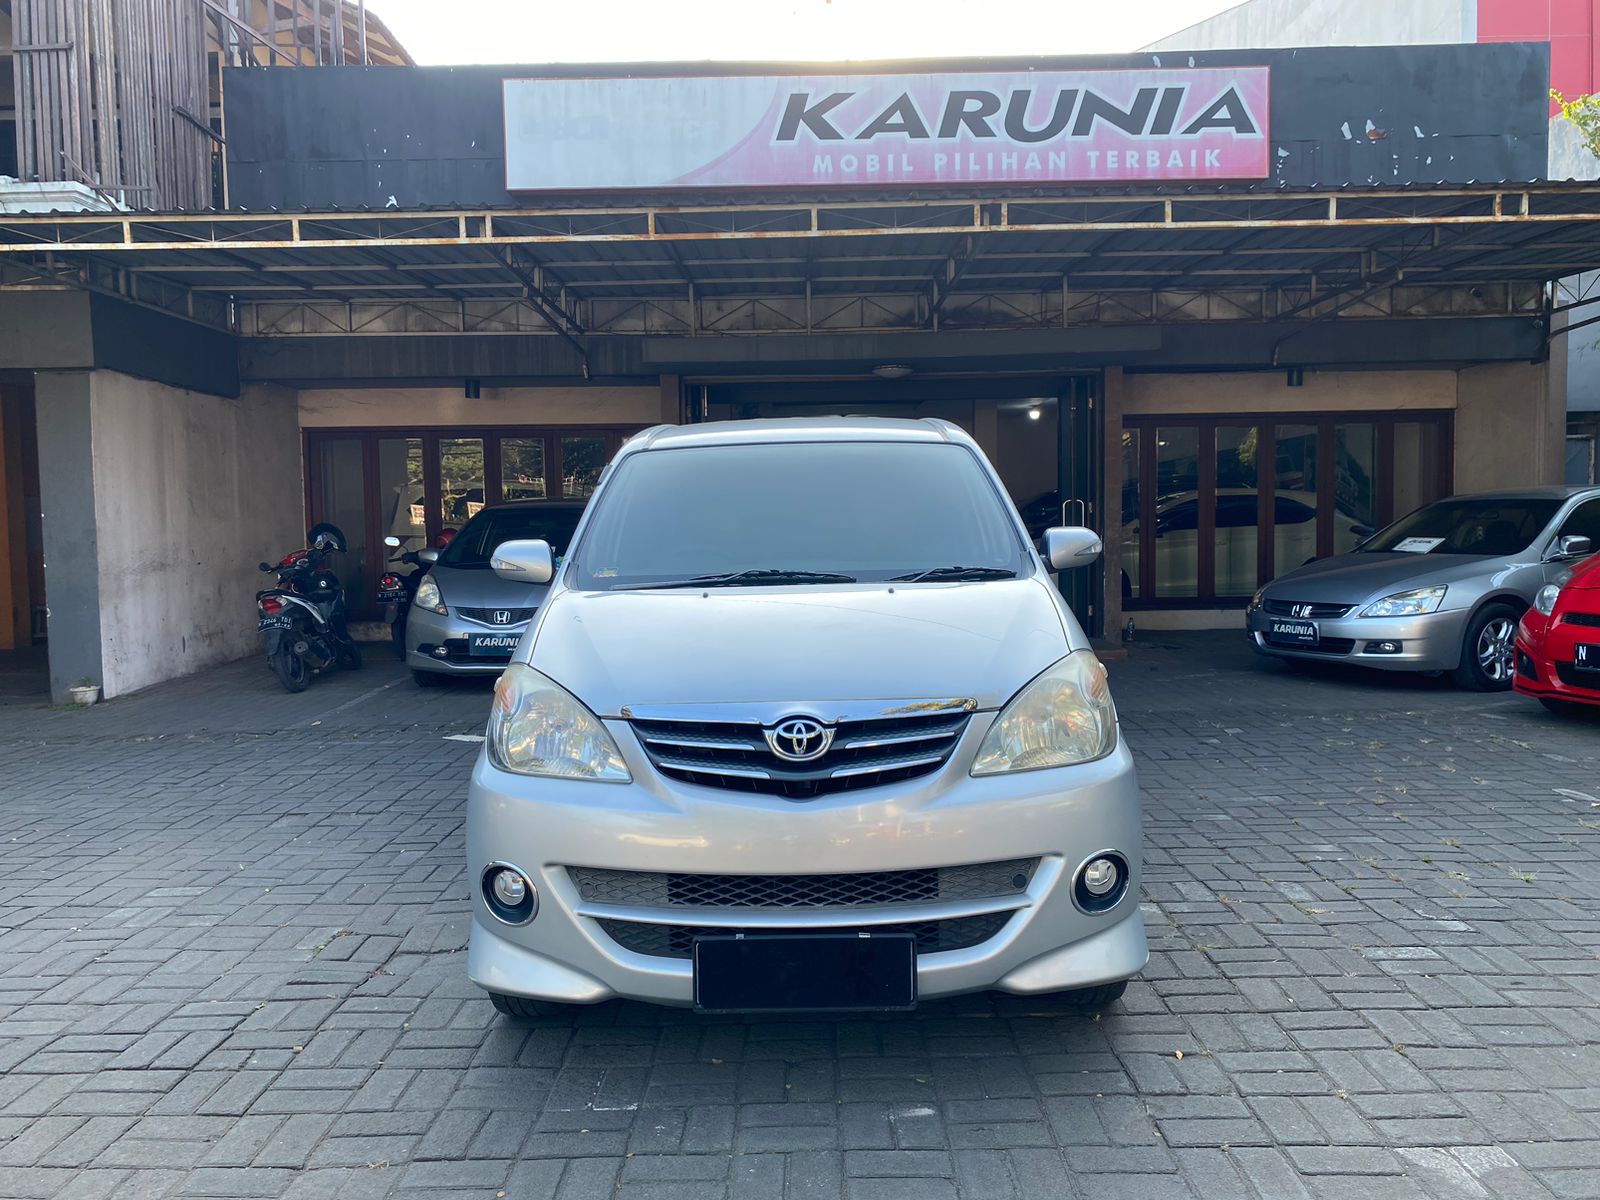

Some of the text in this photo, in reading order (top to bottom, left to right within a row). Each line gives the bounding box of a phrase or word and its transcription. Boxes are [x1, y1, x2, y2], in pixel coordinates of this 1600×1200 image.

[774, 85, 1259, 144] KARUNIA
[812, 149, 1222, 174] MOBIL PILIHAN TERBAIK
[1273, 623, 1314, 636] KARUNIA
[474, 637, 520, 647] KARUNI
[1578, 645, 1587, 660] N
